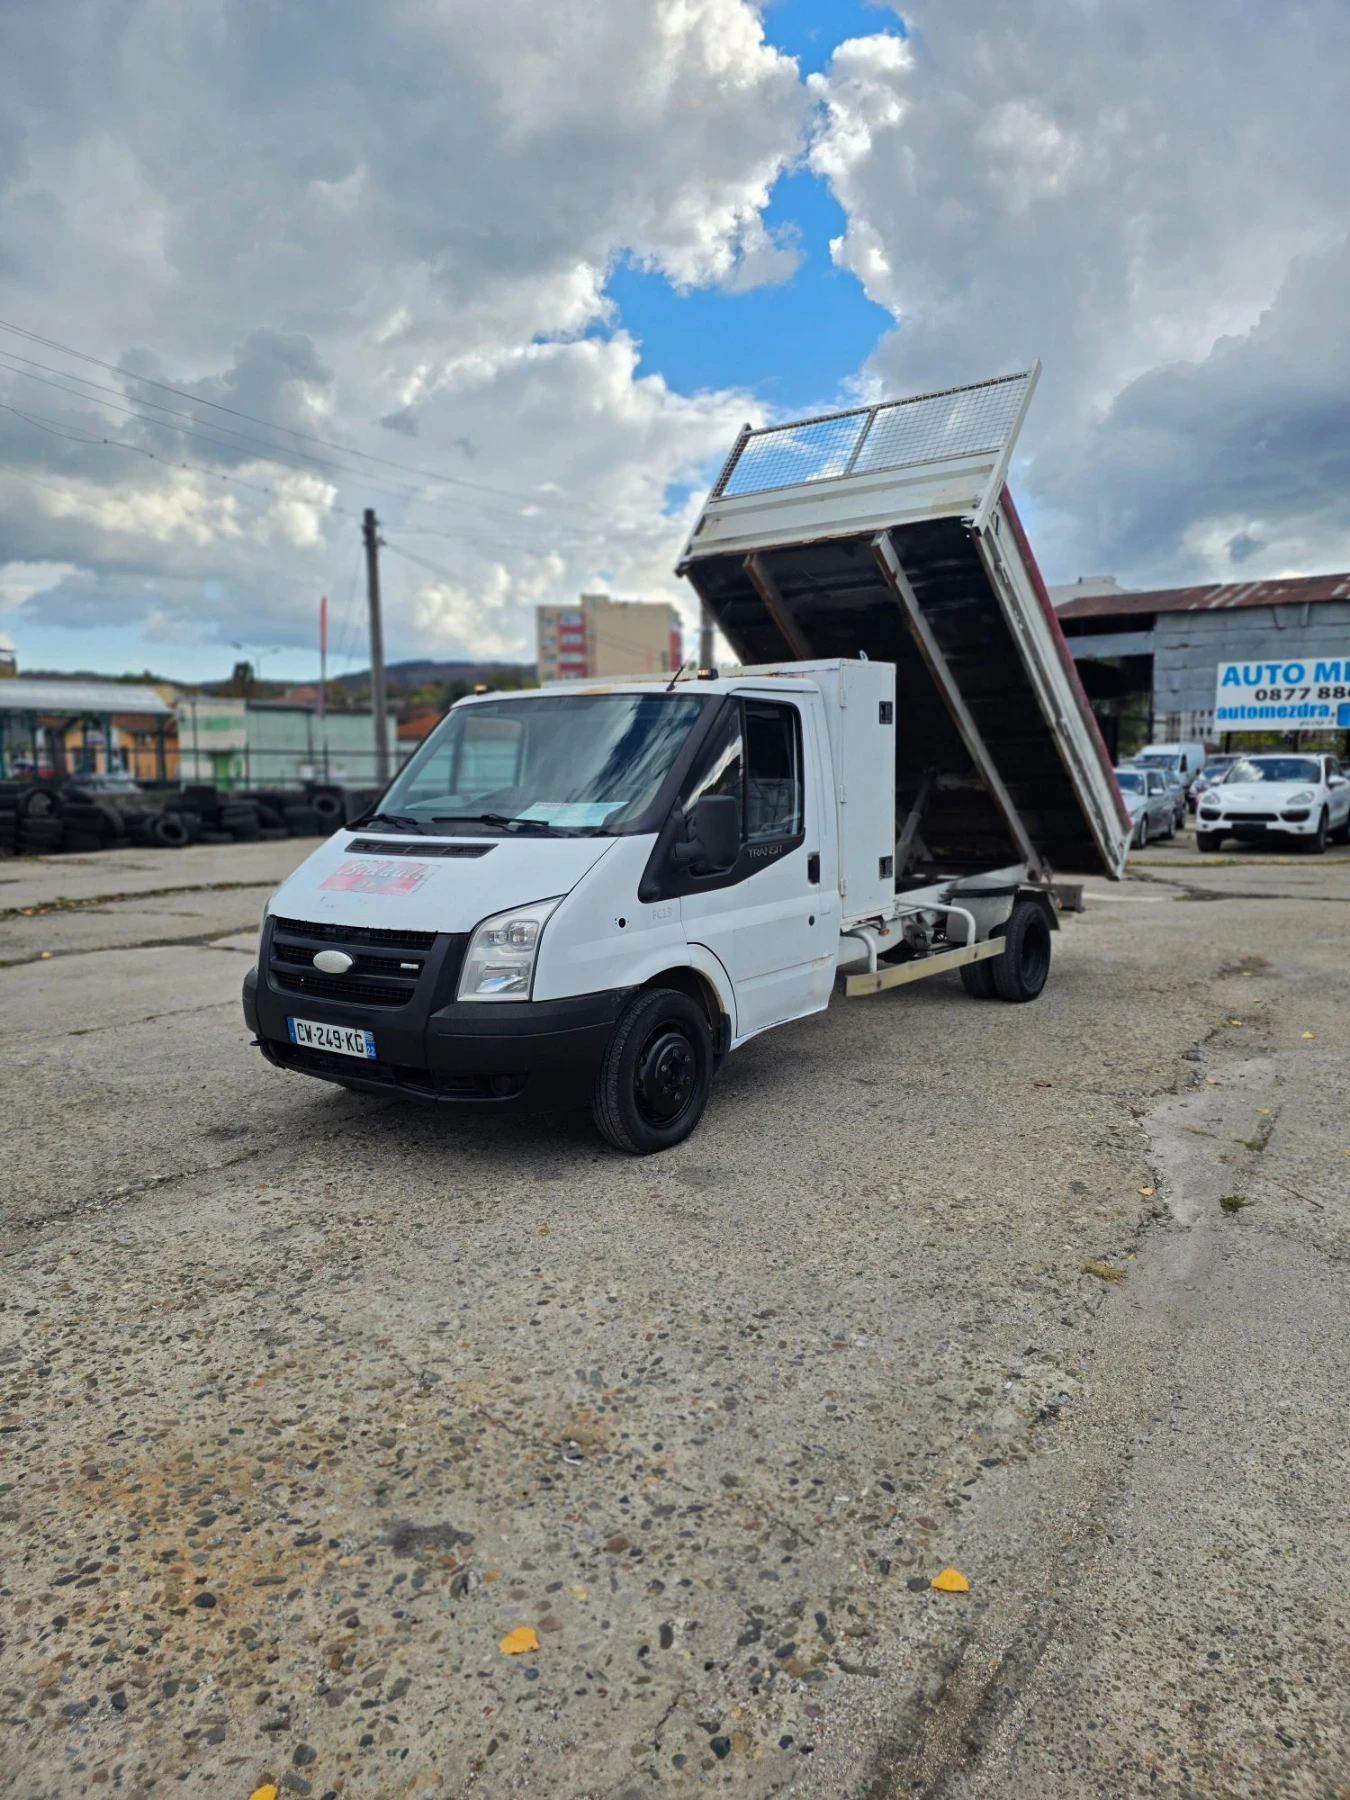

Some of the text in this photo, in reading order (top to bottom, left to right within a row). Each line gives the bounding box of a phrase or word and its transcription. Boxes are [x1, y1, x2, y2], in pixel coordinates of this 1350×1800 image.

[1221, 664, 1305, 686] AUTO
[1255, 686, 1350, 701] 0877 88
[748, 845, 783, 857] TRANSIT
